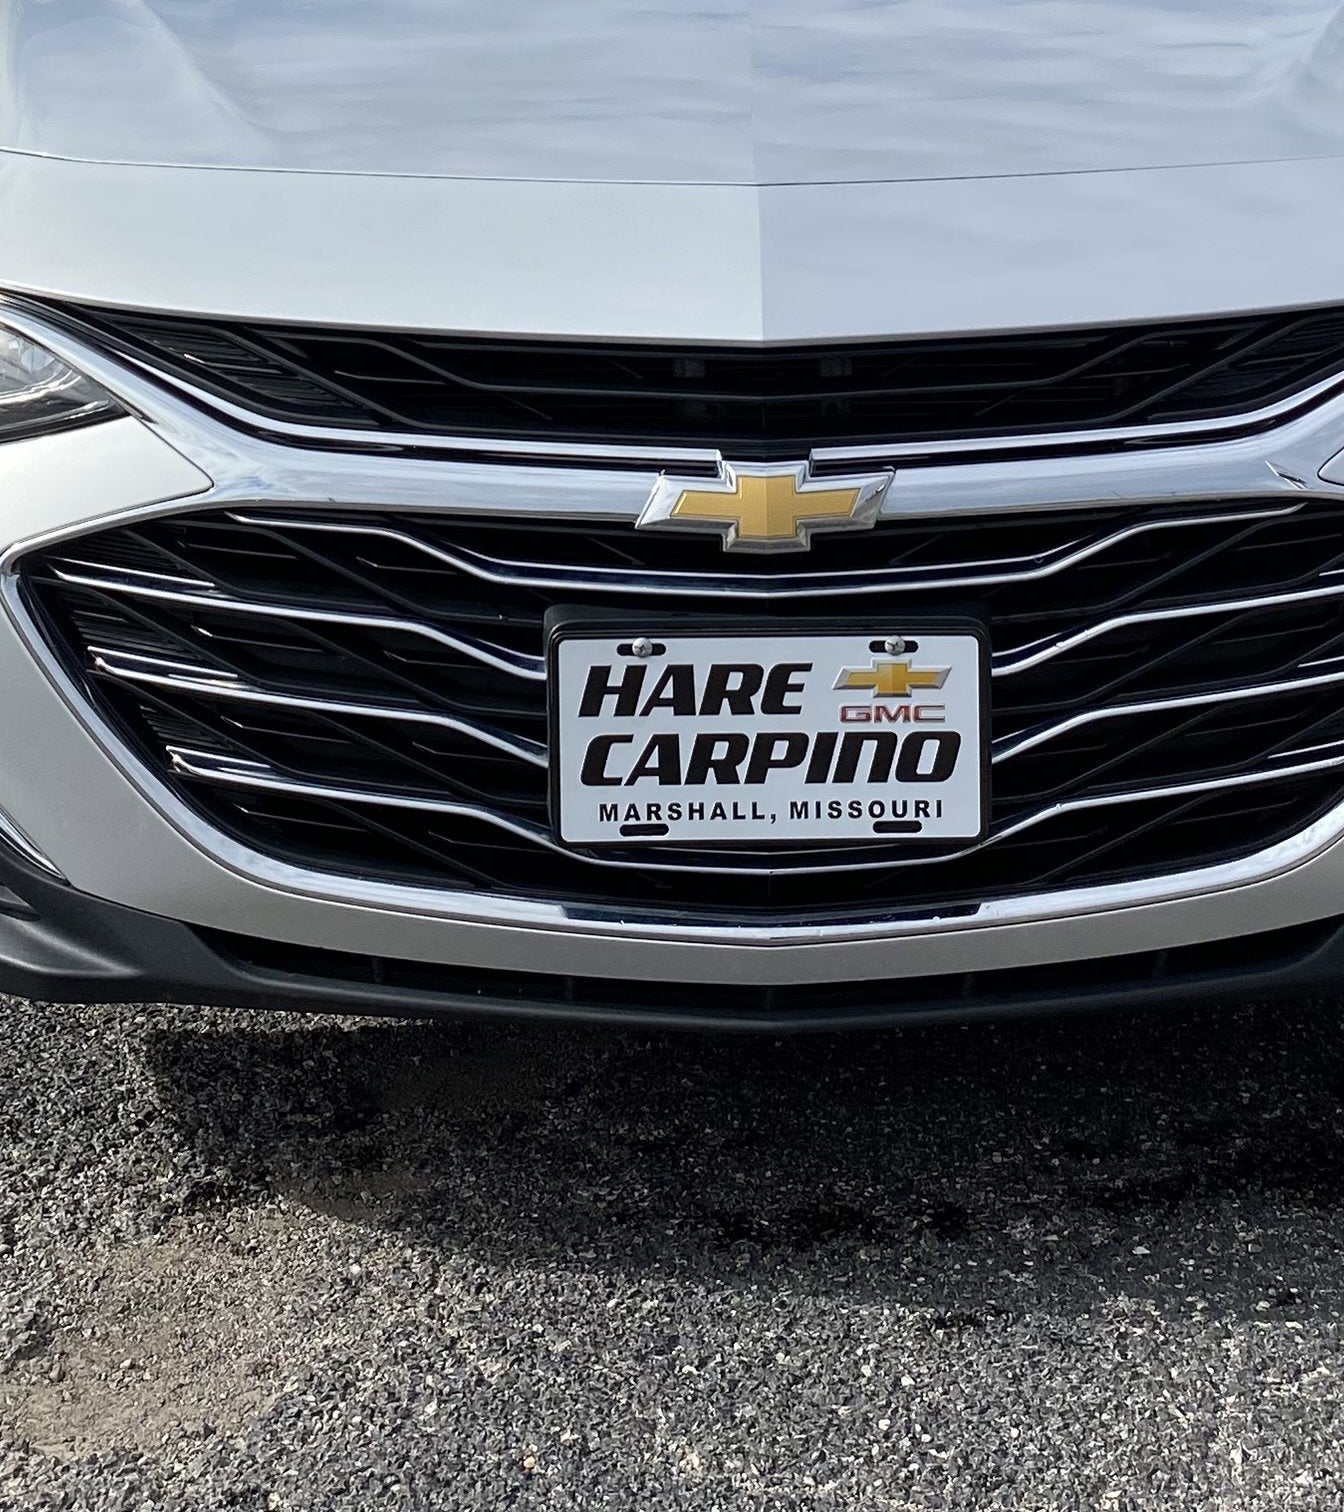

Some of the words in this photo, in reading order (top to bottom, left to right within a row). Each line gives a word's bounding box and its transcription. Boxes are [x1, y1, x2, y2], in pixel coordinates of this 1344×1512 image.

[578, 663, 813, 717] HARE
[839, 704, 946, 724] GMC
[580, 730, 962, 787] CARPINO
[599, 801, 777, 824] MARSHALL,
[789, 799, 942, 820] MISSOURI
